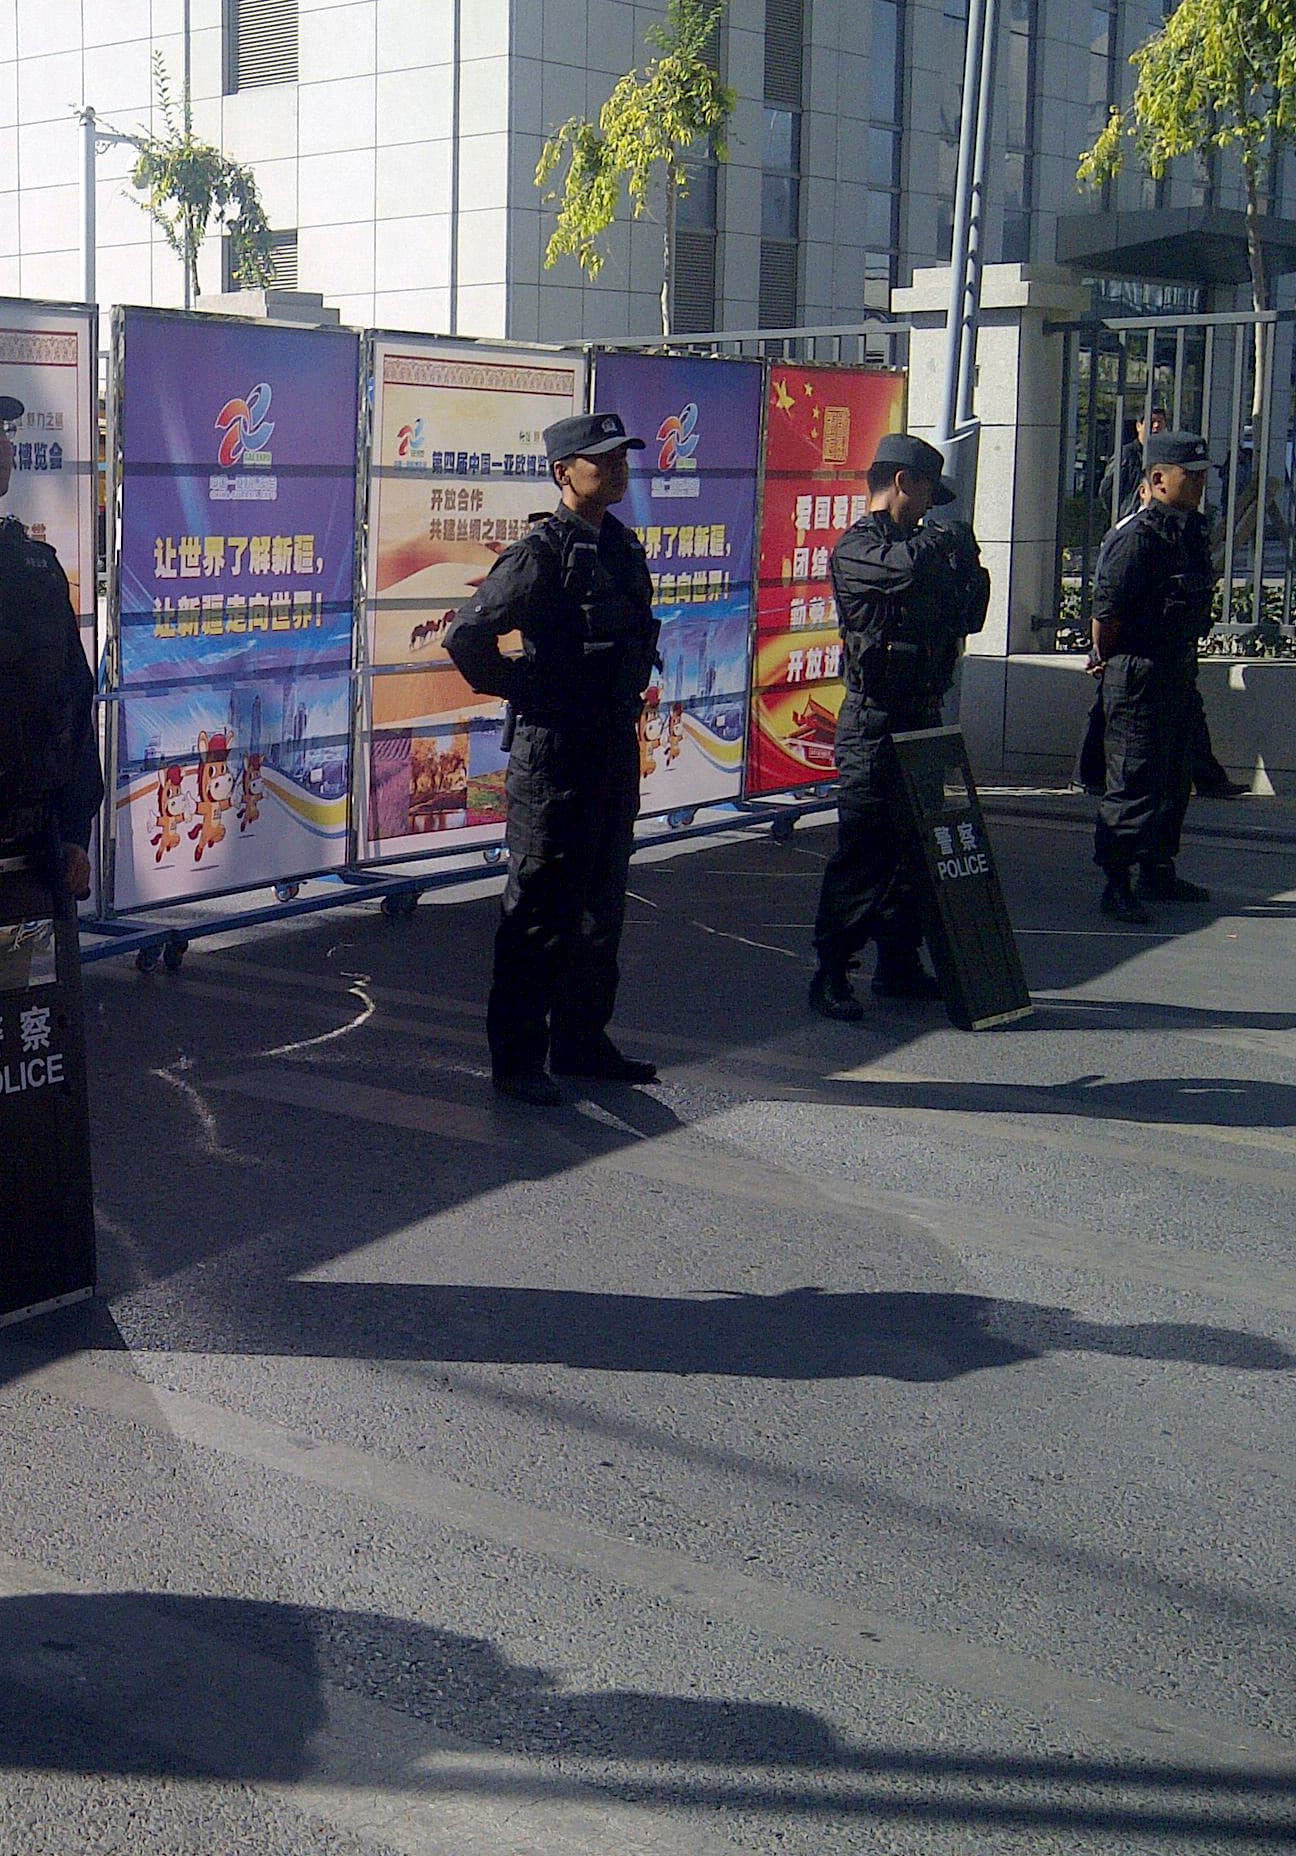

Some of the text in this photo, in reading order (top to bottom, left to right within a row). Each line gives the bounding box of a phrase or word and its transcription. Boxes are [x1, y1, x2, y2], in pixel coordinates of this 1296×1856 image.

[431, 488, 484, 512] 开放合作
[934, 821, 977, 855] 警察
[937, 854, 989, 880] POLICE
